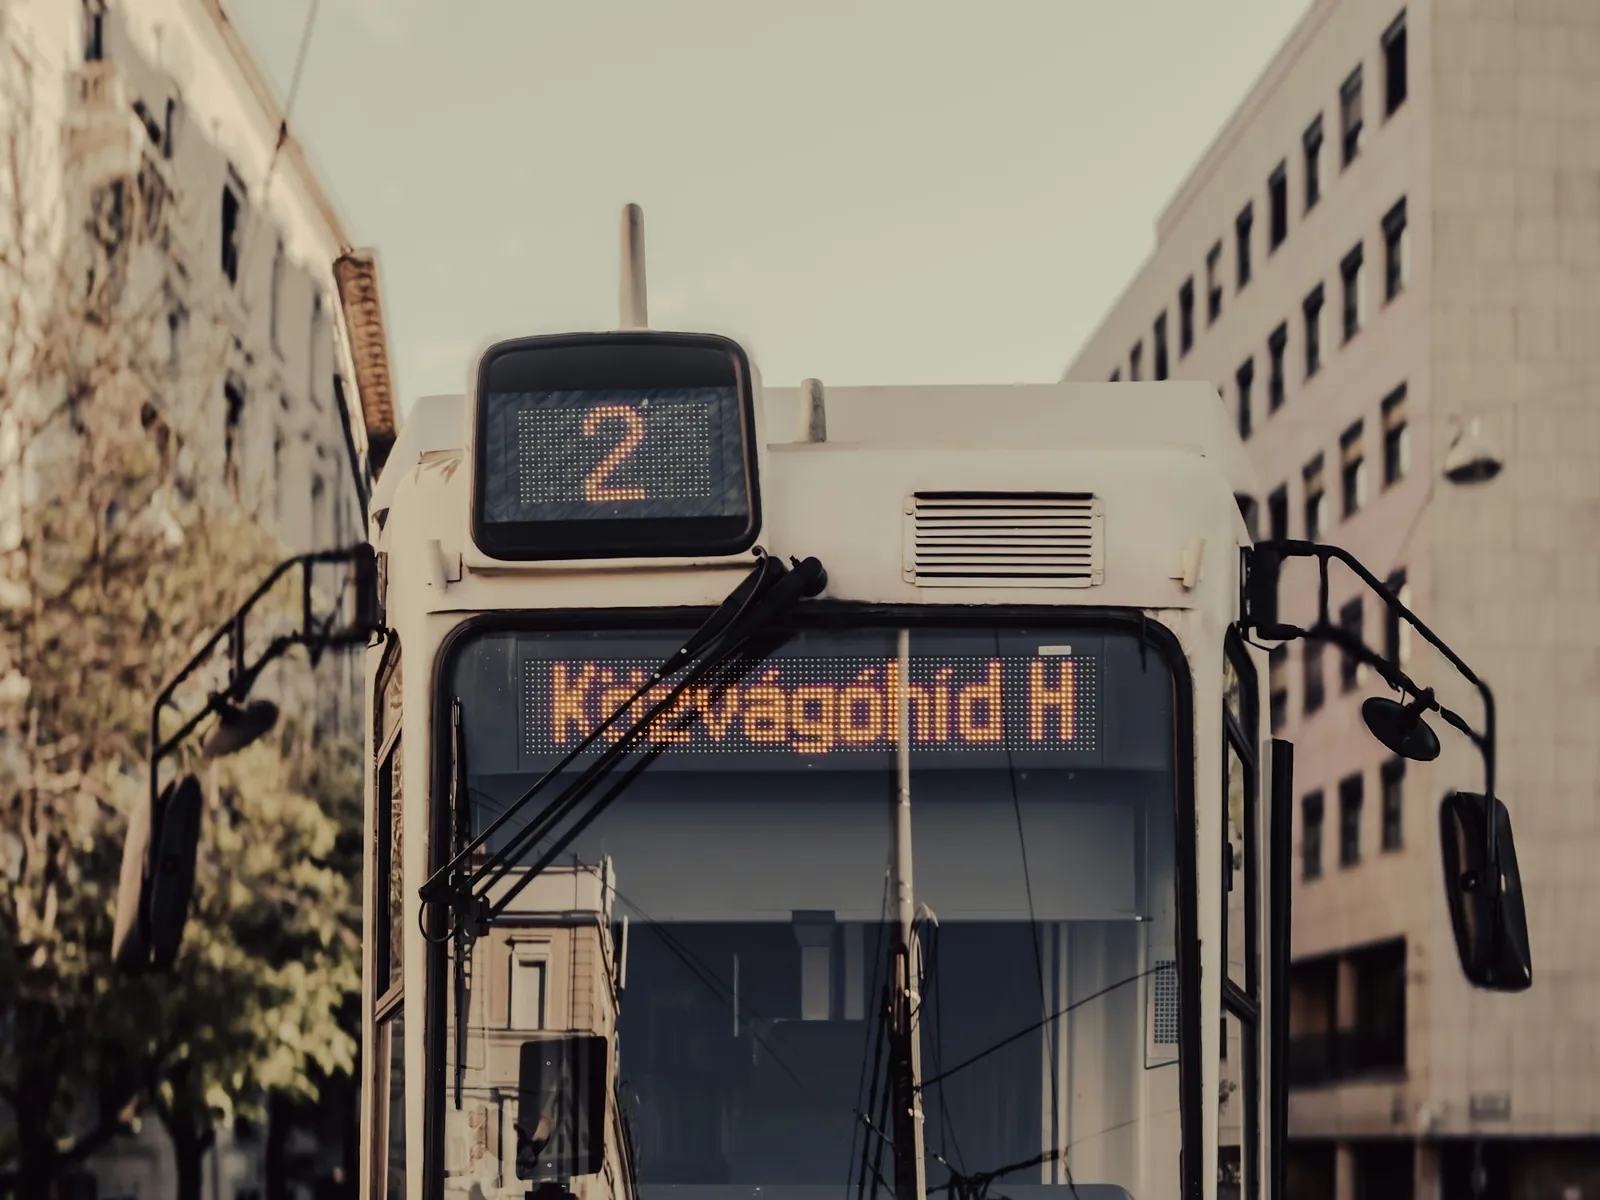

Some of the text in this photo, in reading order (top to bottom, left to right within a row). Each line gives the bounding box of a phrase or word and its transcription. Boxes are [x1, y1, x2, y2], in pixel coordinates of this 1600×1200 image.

[583, 404, 646, 502] 2
[552, 658, 1074, 754] Közvágóhíd H
